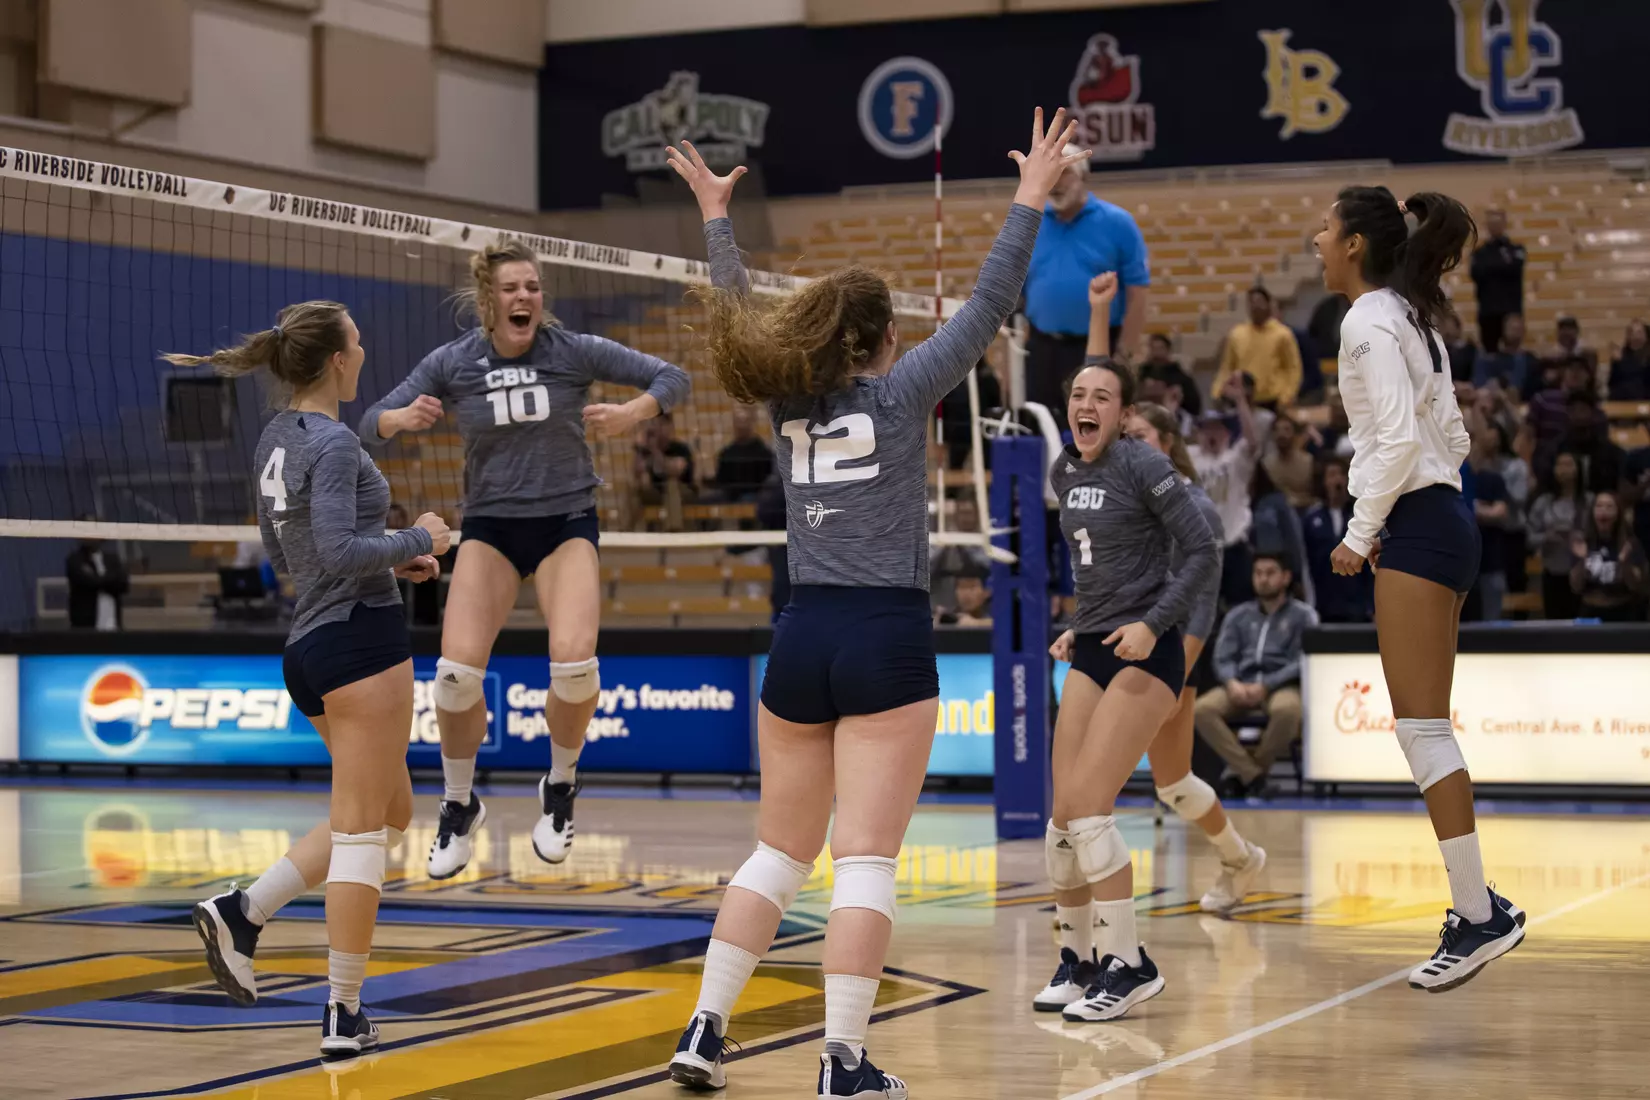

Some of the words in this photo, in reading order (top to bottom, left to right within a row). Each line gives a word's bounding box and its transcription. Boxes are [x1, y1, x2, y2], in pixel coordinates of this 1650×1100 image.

[889, 81, 925, 137] F
[15, 150, 94, 182] RIVERSIDE
[101, 165, 188, 197] VOLLEYBALL
[269, 193, 287, 213] UC
[291, 197, 356, 225] RIVERSIDE
[362, 207, 431, 236] VOLLEYBALL
[573, 241, 630, 267] VOLLEYBALL
[1351, 341, 1371, 360] WAC
[485, 367, 538, 389] CBU
[486, 384, 550, 425] 10
[781, 412, 880, 484] 12
[260, 446, 288, 511] 4
[1151, 475, 1175, 497] WAC
[1067, 486, 1106, 510] CBU
[1073, 527, 1093, 565] 1
[138, 688, 293, 729] PEPSI
[640, 683, 735, 710] favorite
[1481, 718, 1545, 735] Central
